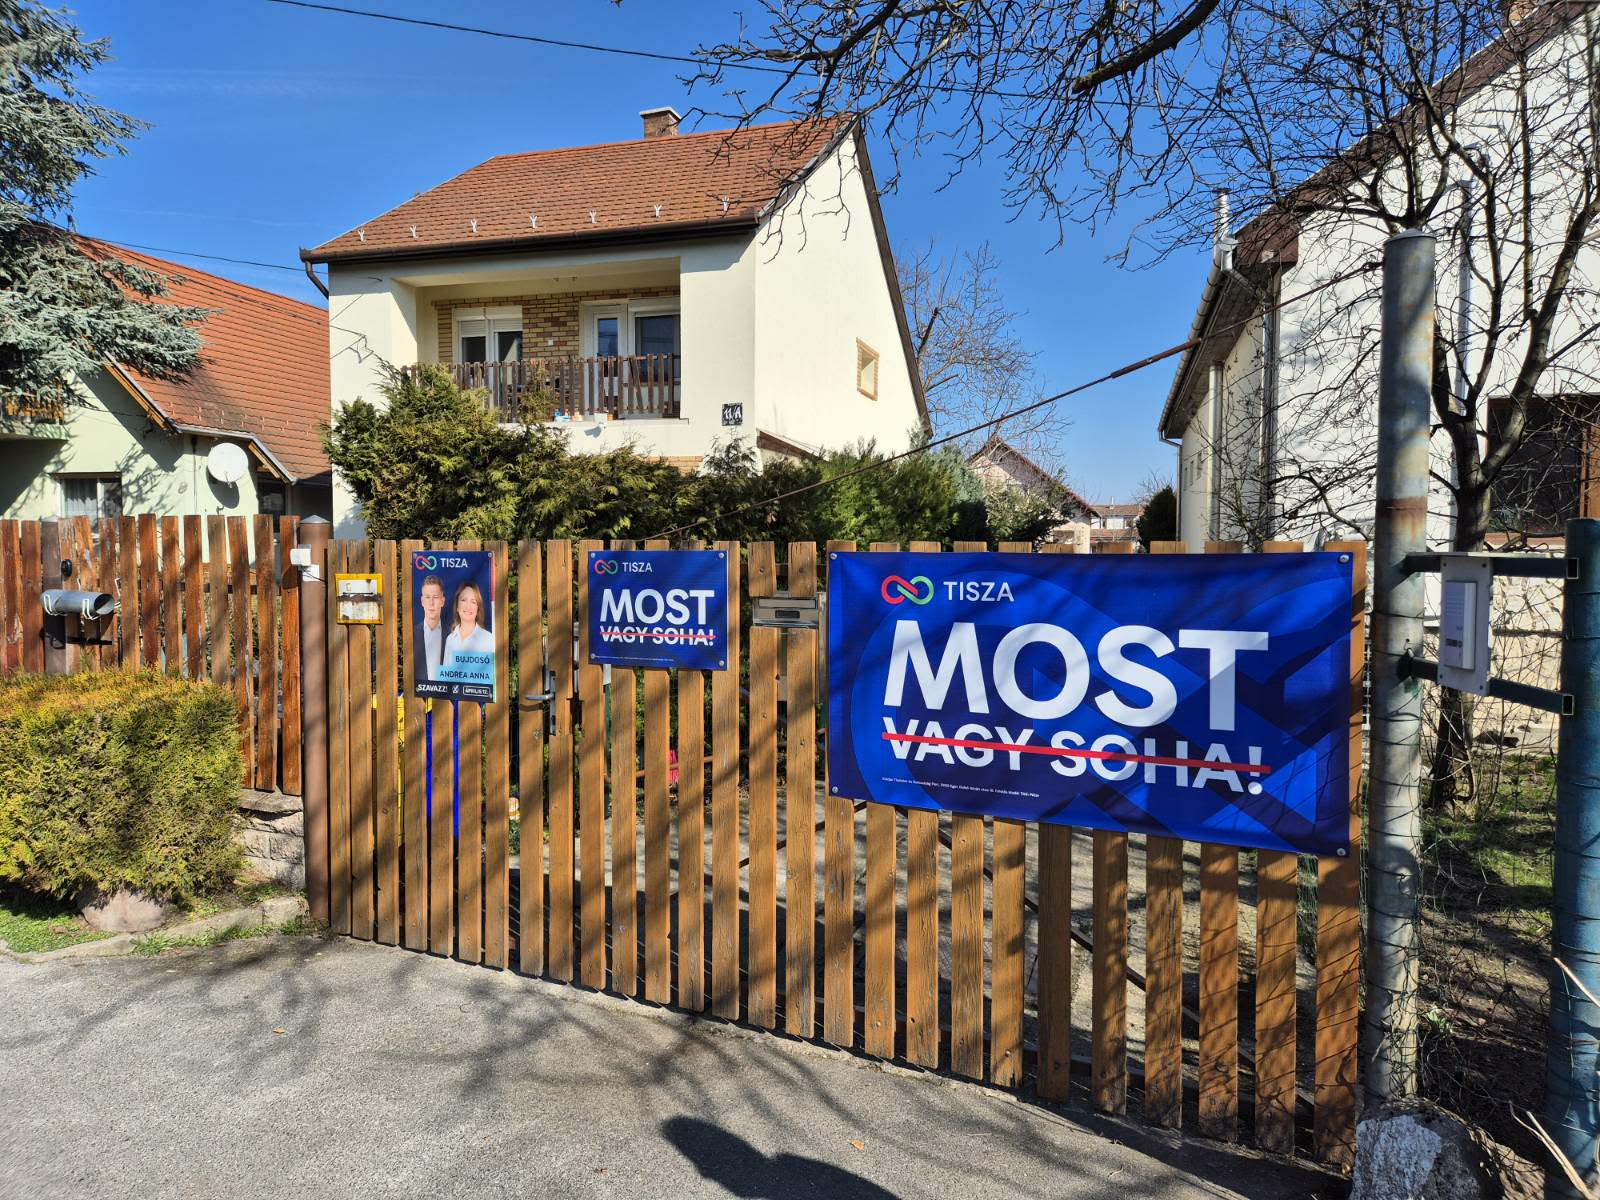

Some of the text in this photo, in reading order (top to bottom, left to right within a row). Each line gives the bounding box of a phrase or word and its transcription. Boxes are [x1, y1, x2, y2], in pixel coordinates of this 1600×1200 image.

[440, 557, 468, 568] TISZA
[622, 562, 653, 573] TISZA
[943, 580, 1015, 602] TISZA
[600, 588, 715, 625] MOST
[600, 625, 715, 646] VAGY SOHA!
[455, 654, 490, 665] BUJDOSÓ
[440, 670, 490, 680] ANDREA ANNA
[883, 619, 1269, 731] MOST
[883, 716, 1264, 796] VAGY SOHA!
